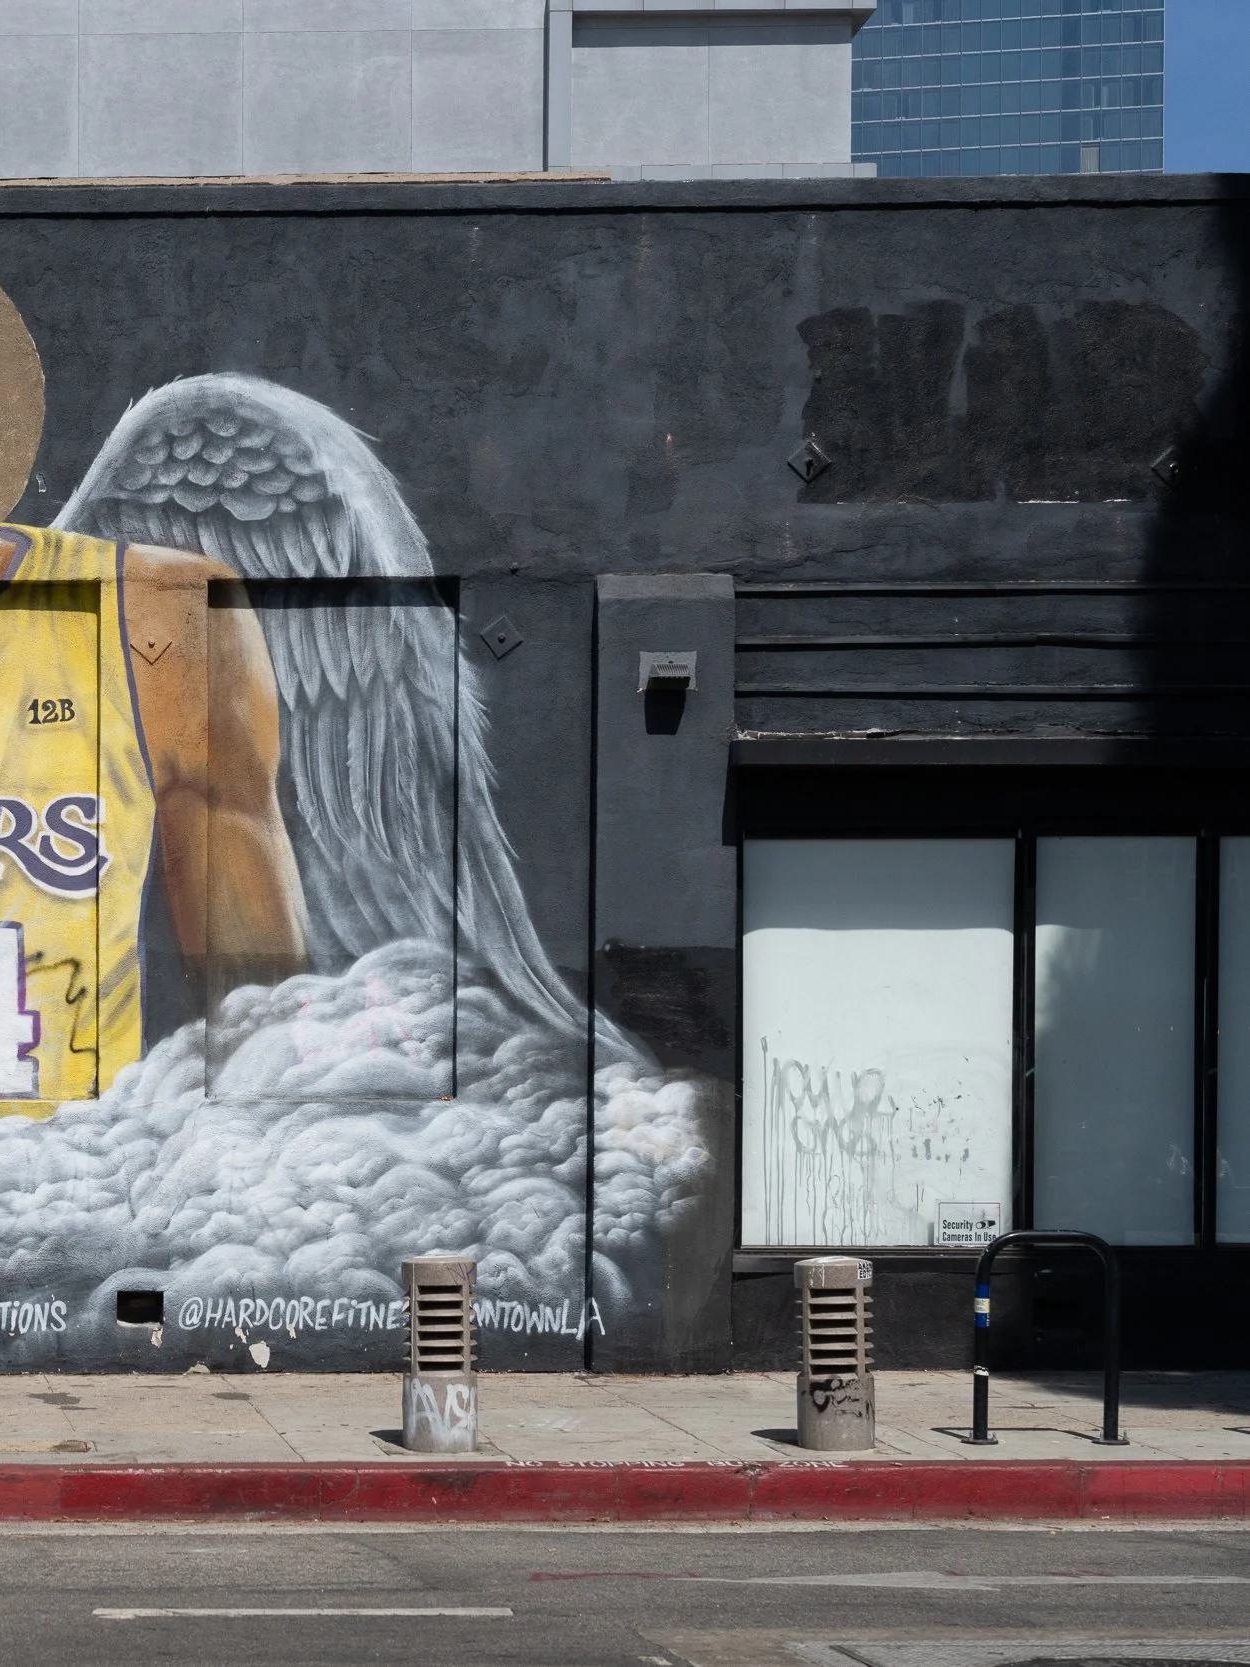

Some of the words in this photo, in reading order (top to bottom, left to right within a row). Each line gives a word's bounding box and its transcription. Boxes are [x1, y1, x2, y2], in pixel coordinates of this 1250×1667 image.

[27, 698, 76, 725] 12B
[942, 1219, 974, 1231] Security
[942, 1231, 973, 1242] Cameras
[974, 1231, 982, 1242] In
[983, 1231, 997, 1242] Use
